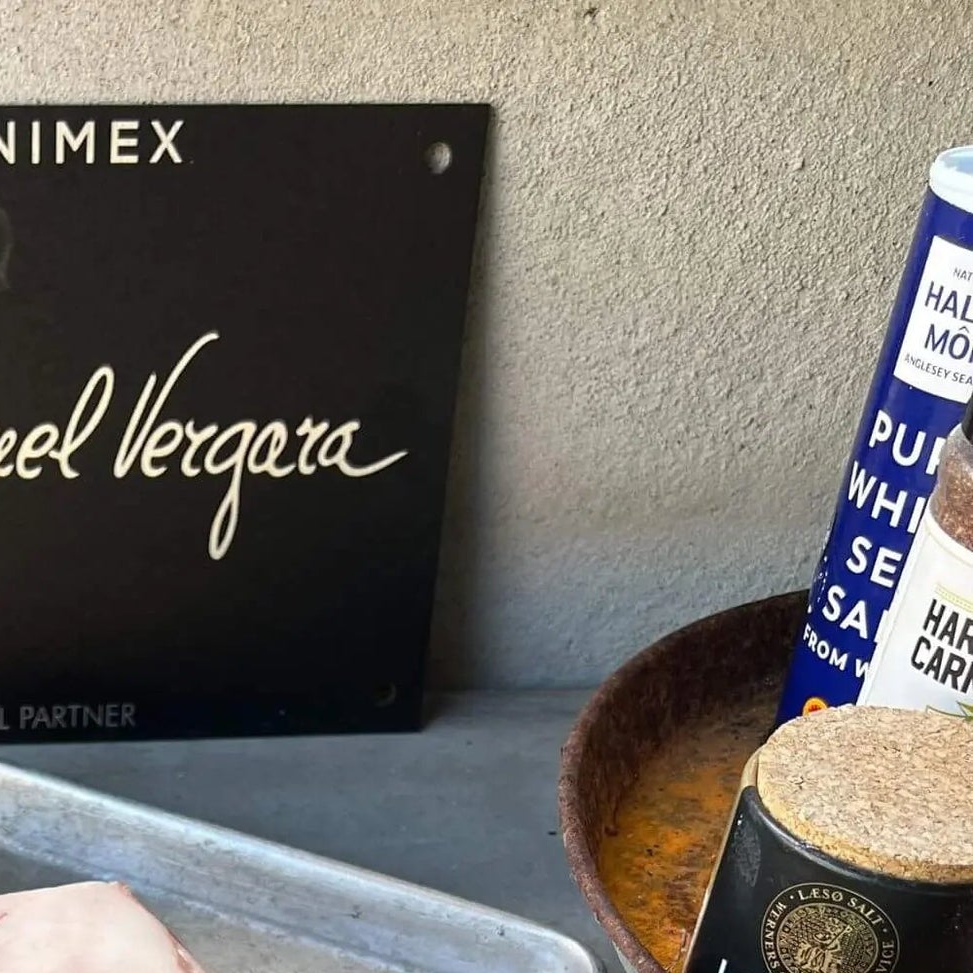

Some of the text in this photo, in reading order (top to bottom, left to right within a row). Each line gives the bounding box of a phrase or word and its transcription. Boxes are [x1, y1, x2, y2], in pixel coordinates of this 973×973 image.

[924, 323, 973, 364] MÔ
[904, 352, 951, 380] ANGLESEY
[112, 330, 410, 561] Vergara
[803, 622, 849, 671] FROM
[20, 703, 137, 730] PARTNER
[798, 887, 885, 925] LÆSØ SALT
[764, 900, 787, 970] WERNERS
